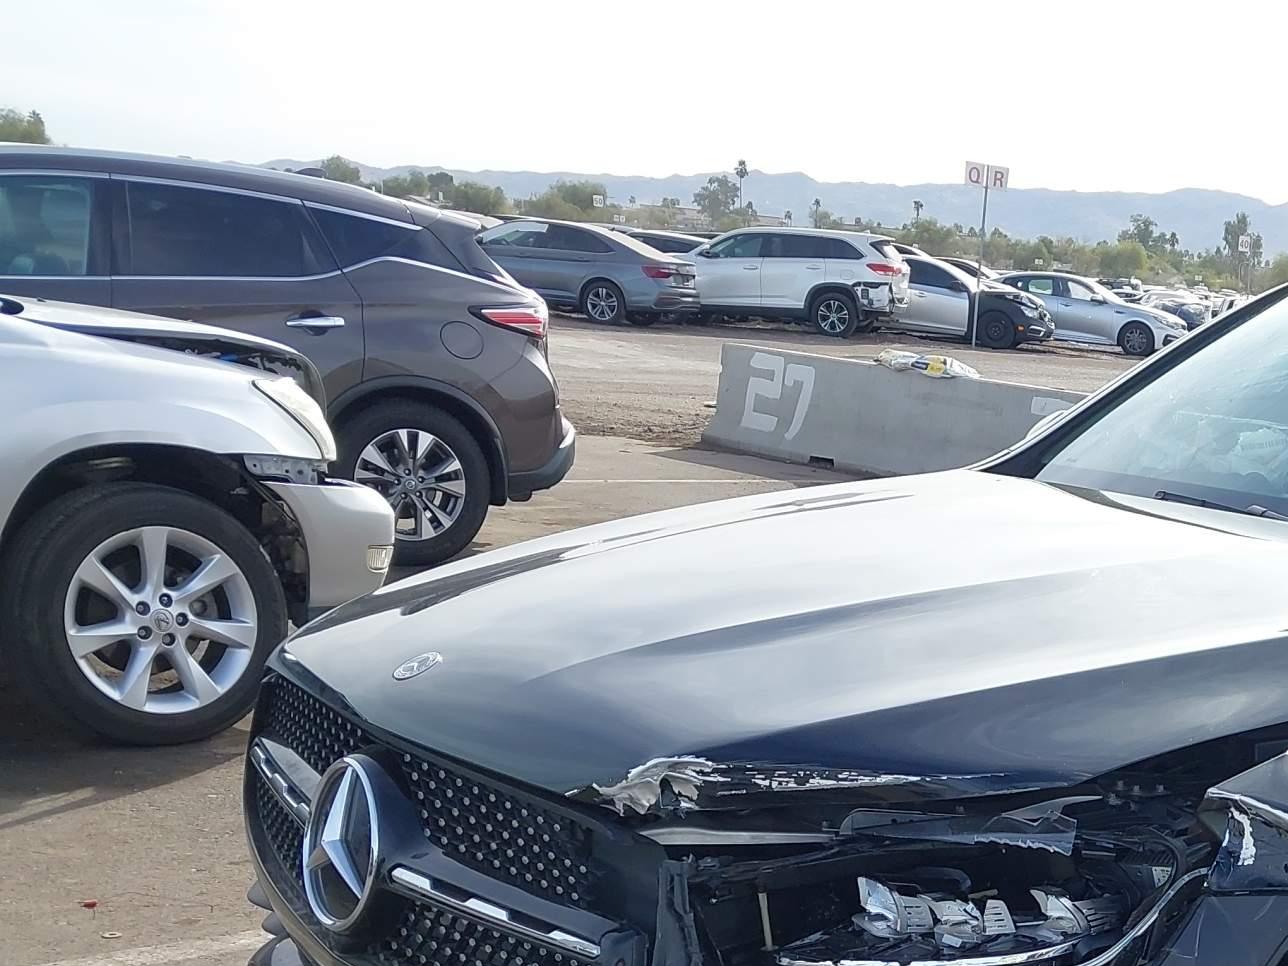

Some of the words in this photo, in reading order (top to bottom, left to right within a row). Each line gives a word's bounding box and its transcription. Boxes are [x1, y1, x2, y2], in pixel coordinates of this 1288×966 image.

[968, 166, 981, 184] Q
[993, 170, 1005, 188] R
[593, 197, 603, 205] 50
[1239, 239, 1249, 249] 40
[740, 351, 816, 441] 27
